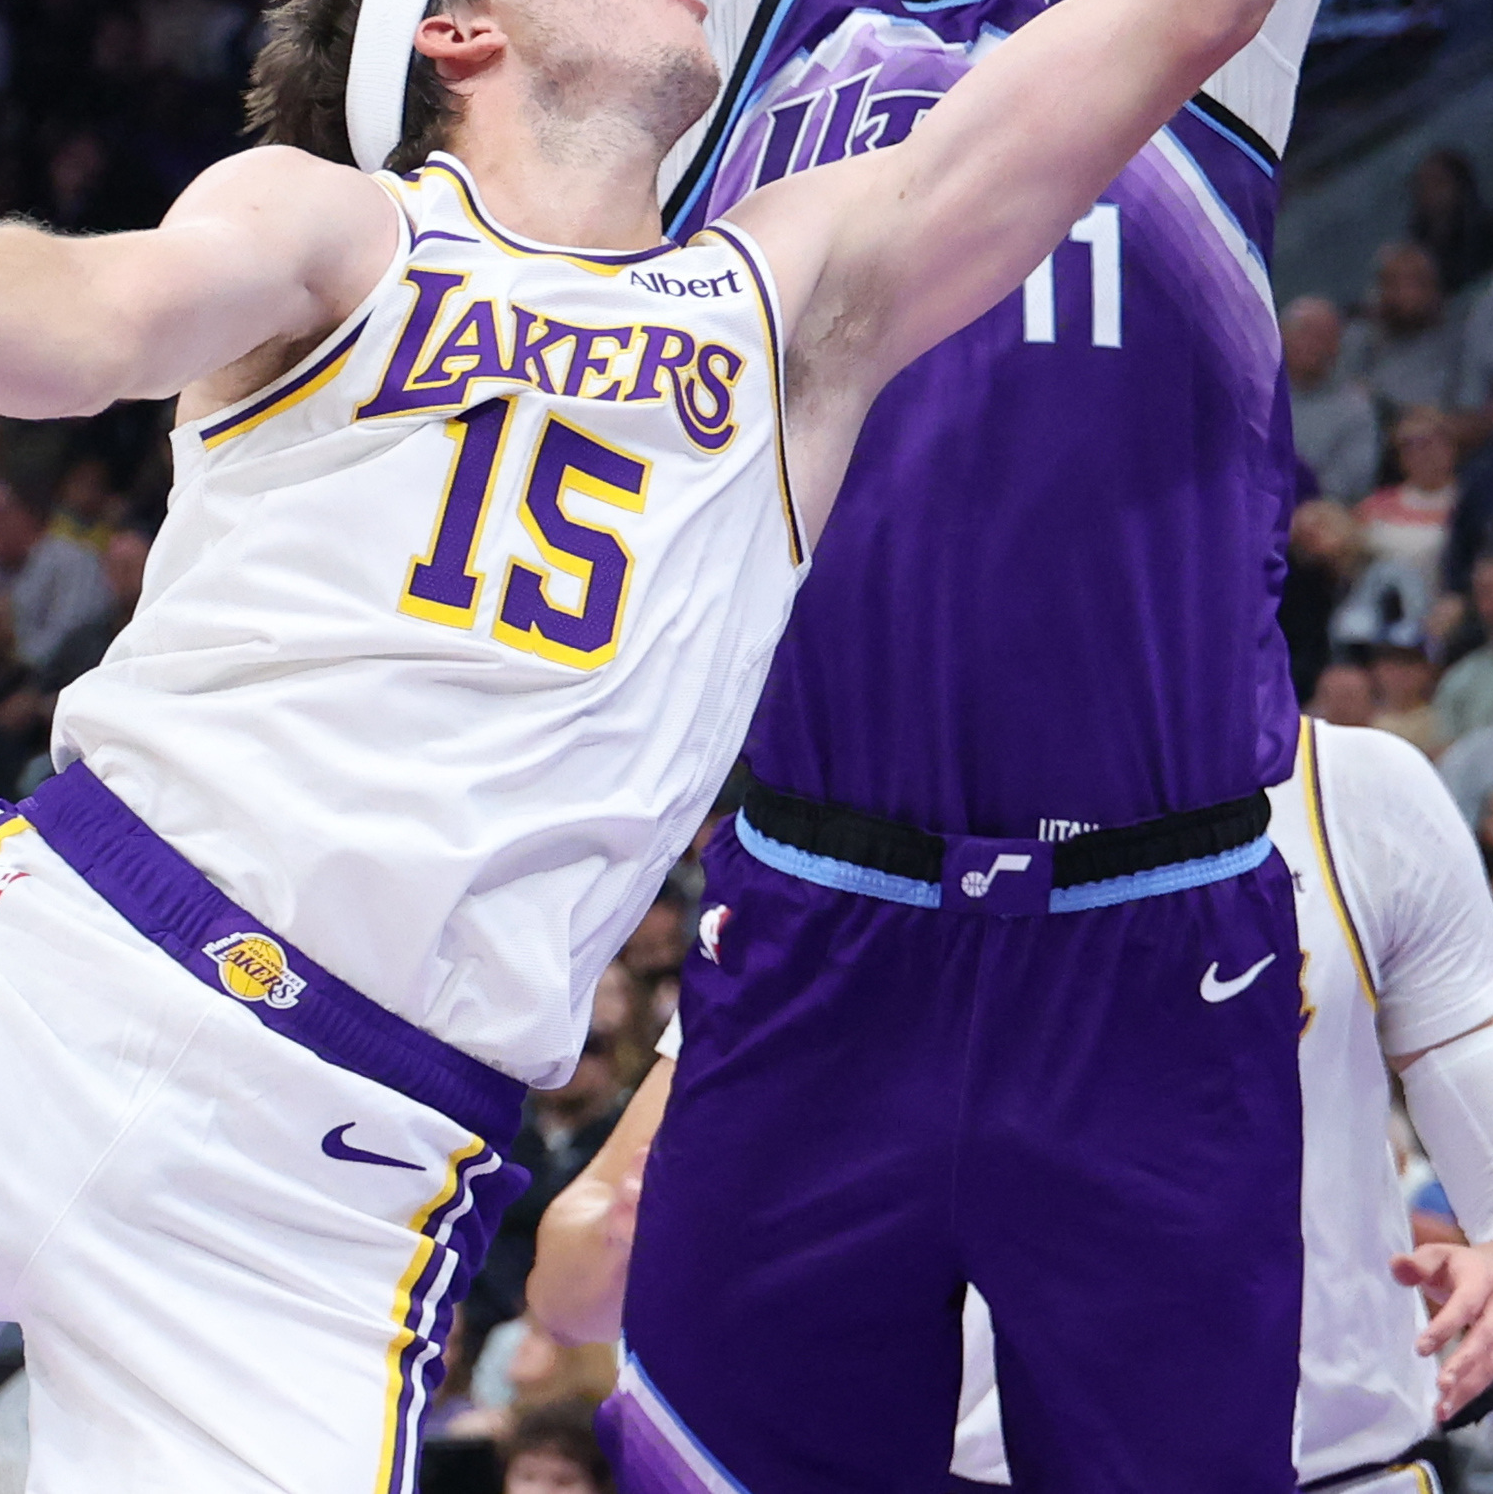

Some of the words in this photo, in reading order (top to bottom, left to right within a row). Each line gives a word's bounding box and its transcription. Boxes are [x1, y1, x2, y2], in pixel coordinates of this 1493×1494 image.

[628, 268, 744, 298] Albert
[1021, 202, 1122, 348] 11
[353, 266, 747, 455] LAKERS
[397, 395, 654, 671] 15
[210, 937, 297, 1006] LAKERS
